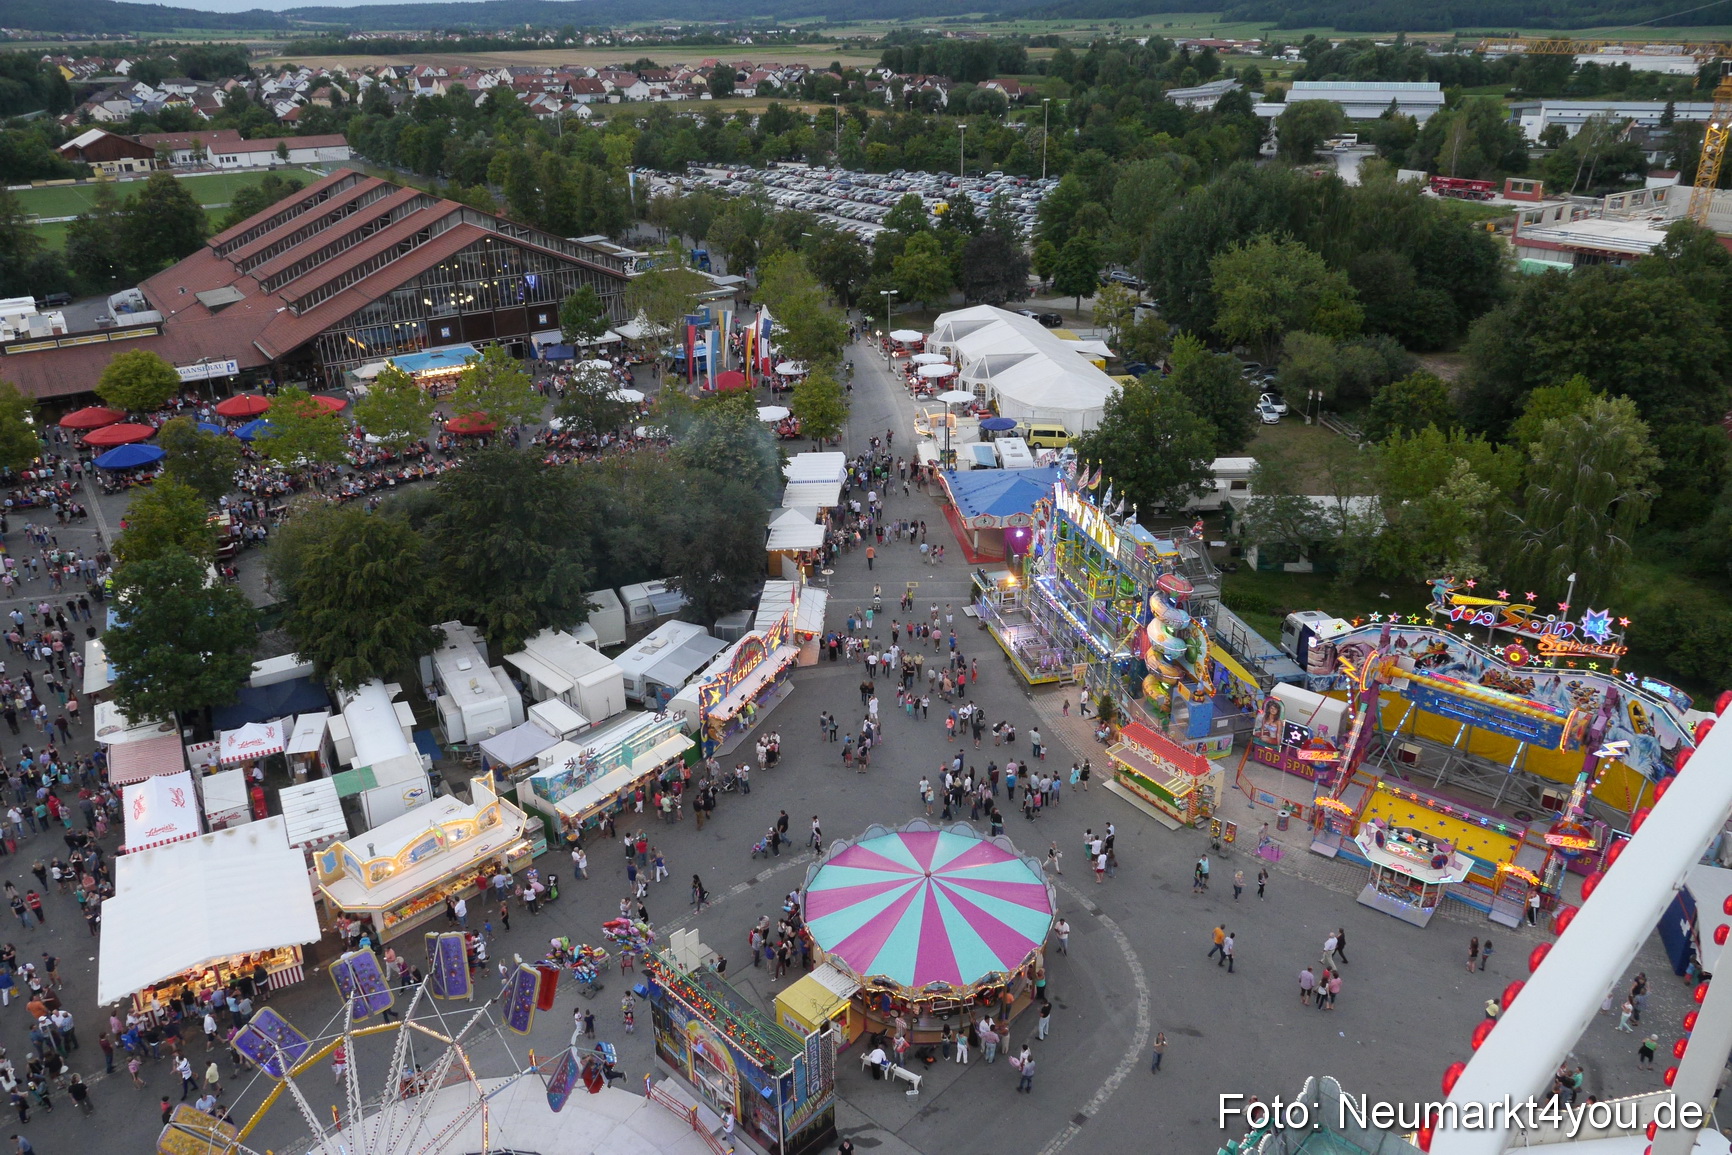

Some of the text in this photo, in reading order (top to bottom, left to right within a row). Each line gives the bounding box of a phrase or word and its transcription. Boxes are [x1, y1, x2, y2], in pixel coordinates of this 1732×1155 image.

[732, 651, 763, 687] SCHUSS
[1257, 748, 1315, 777] TOP SPIN
